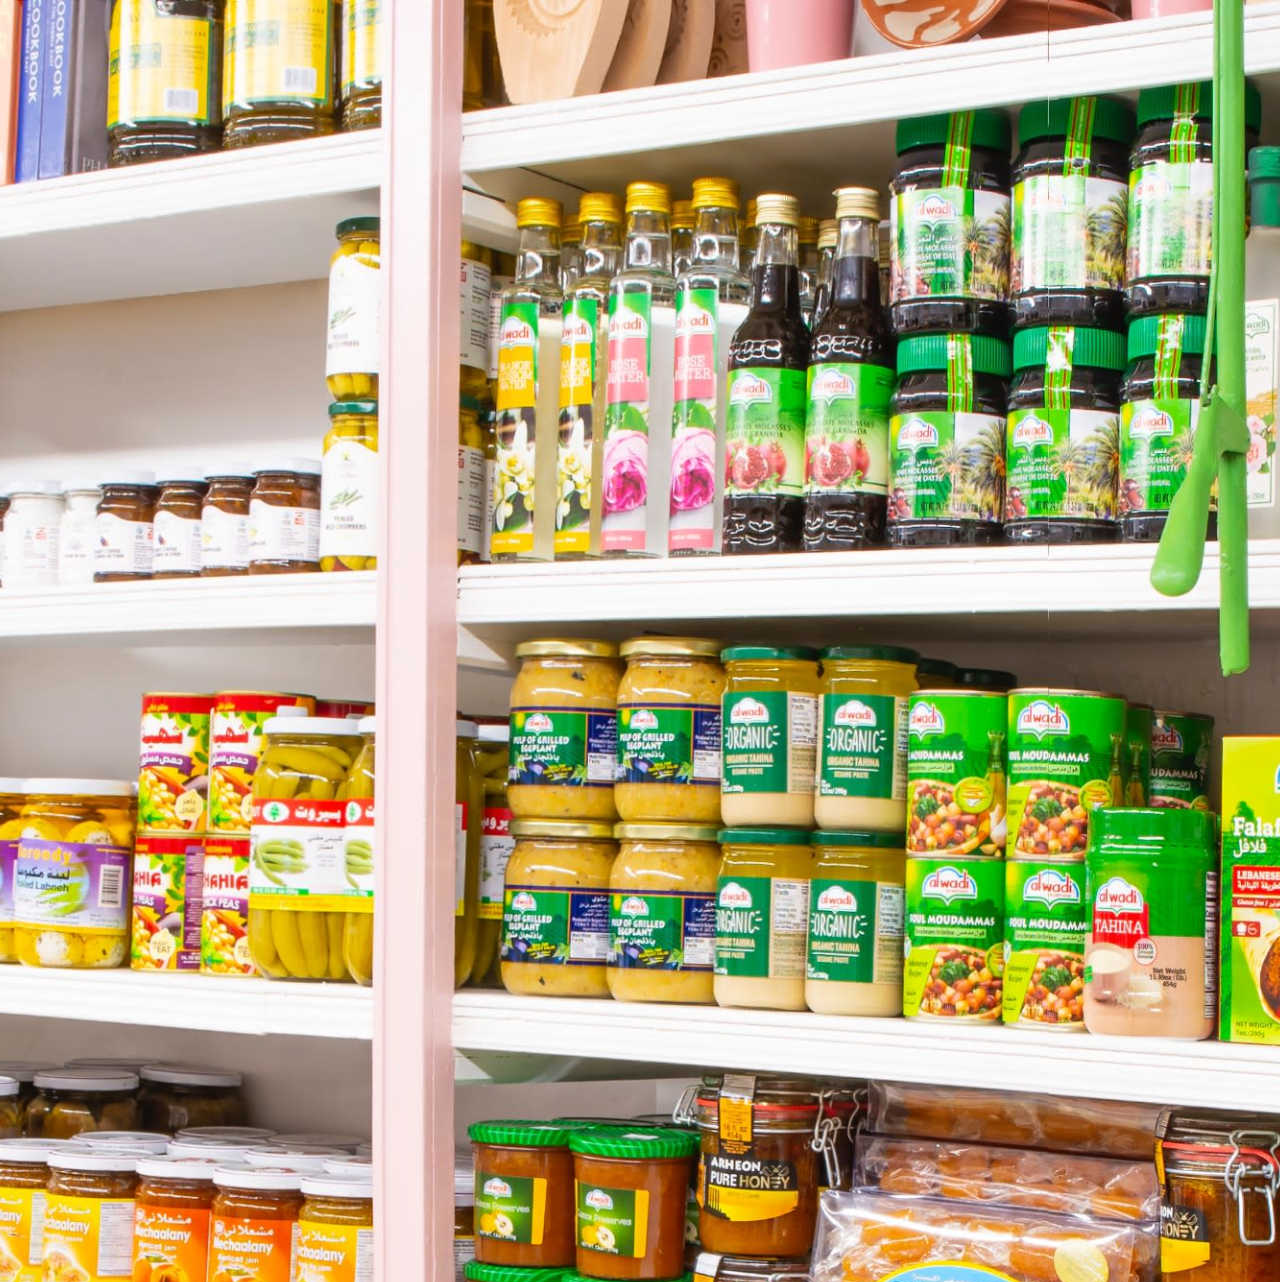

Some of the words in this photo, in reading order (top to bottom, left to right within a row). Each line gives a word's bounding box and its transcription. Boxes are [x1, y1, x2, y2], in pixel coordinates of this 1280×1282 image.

[727, 725, 773, 749] ORGANIC
[830, 728, 881, 753] ORGANIC
[294, 807, 341, 822] بيروت
[1233, 838, 1267, 858] فلافل
[1237, 870, 1280, 880] LEBANESE
[813, 914, 861, 938] ORGANIC
[928, 915, 995, 926] MOUDAMMAS
[1094, 918, 1144, 934] TAHINA
[710, 1157, 762, 1172] ARHEON
[710, 1172, 737, 1188] PURE
[739, 1173, 790, 1189] HONEY
